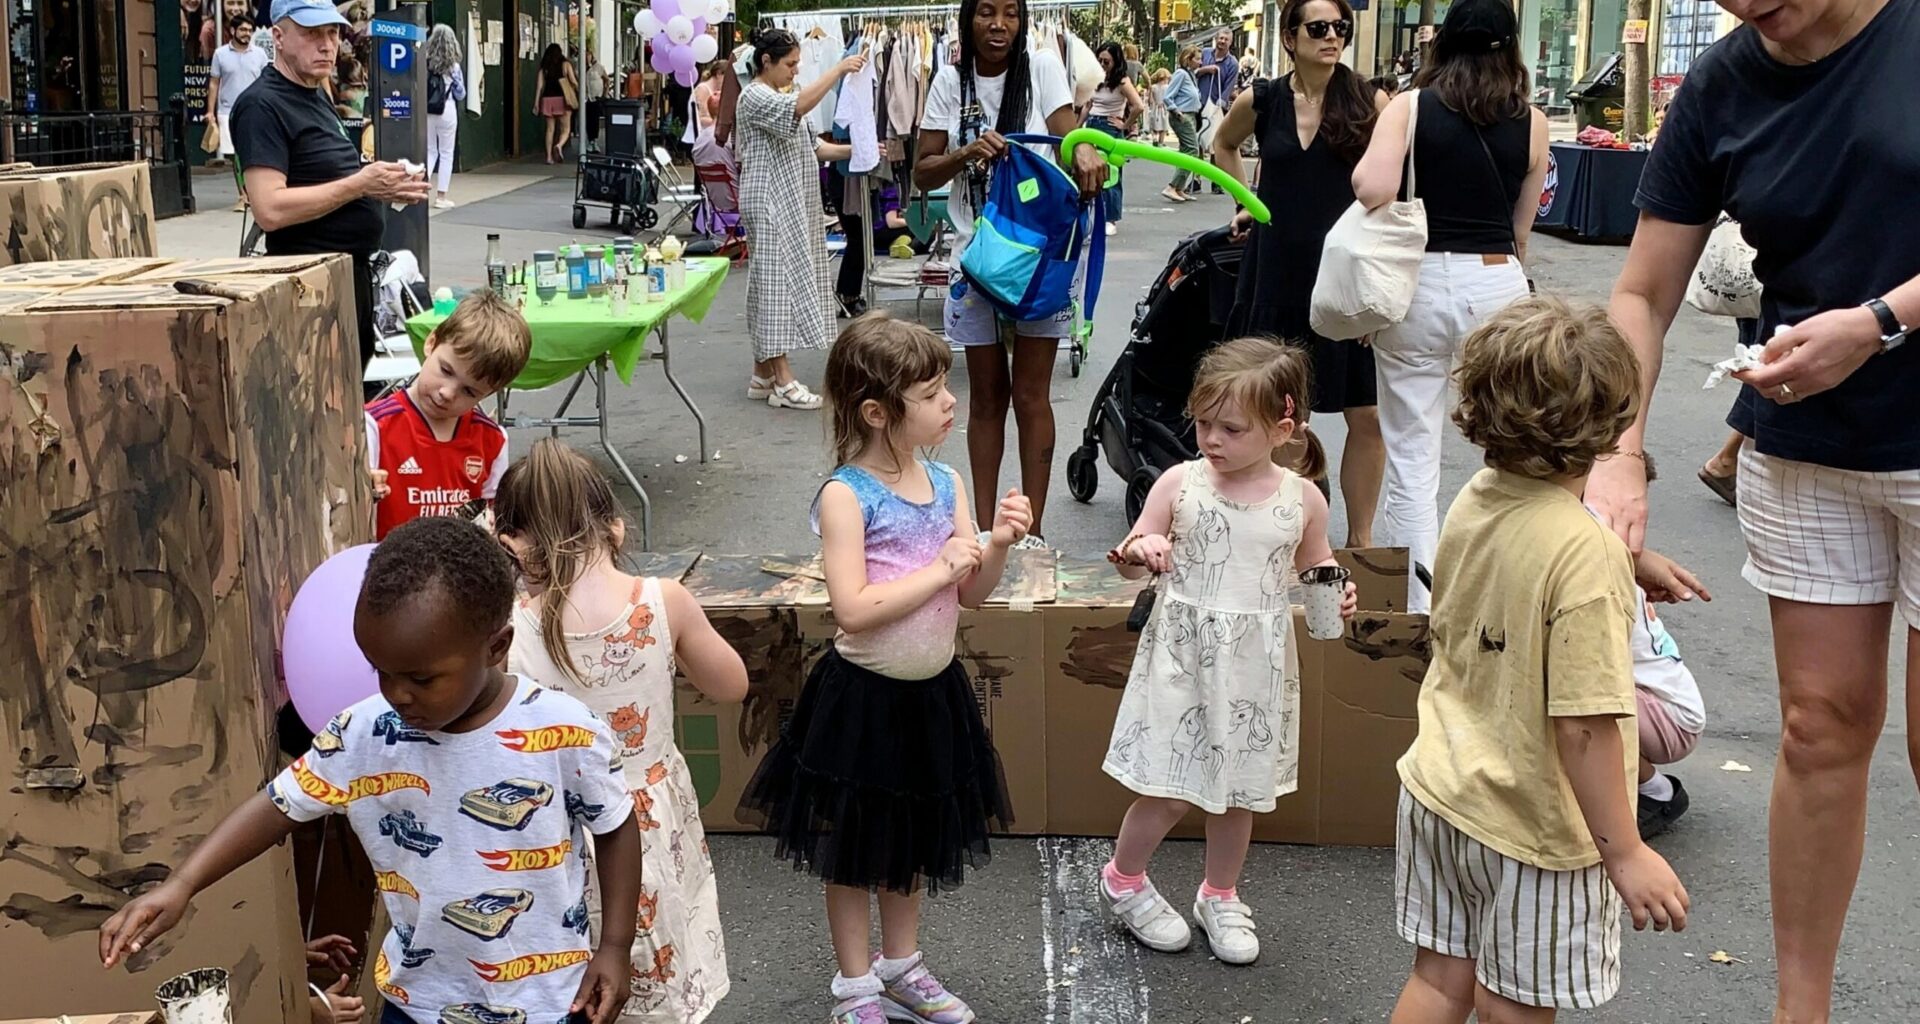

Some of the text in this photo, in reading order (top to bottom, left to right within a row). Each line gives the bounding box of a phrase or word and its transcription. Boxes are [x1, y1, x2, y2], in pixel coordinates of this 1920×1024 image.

[390, 43, 407, 69] P
[184, 76, 207, 86] NEW
[184, 87, 208, 97] PRES
[407, 485, 471, 504] Emirates
[990, 676, 1002, 699] NAME
